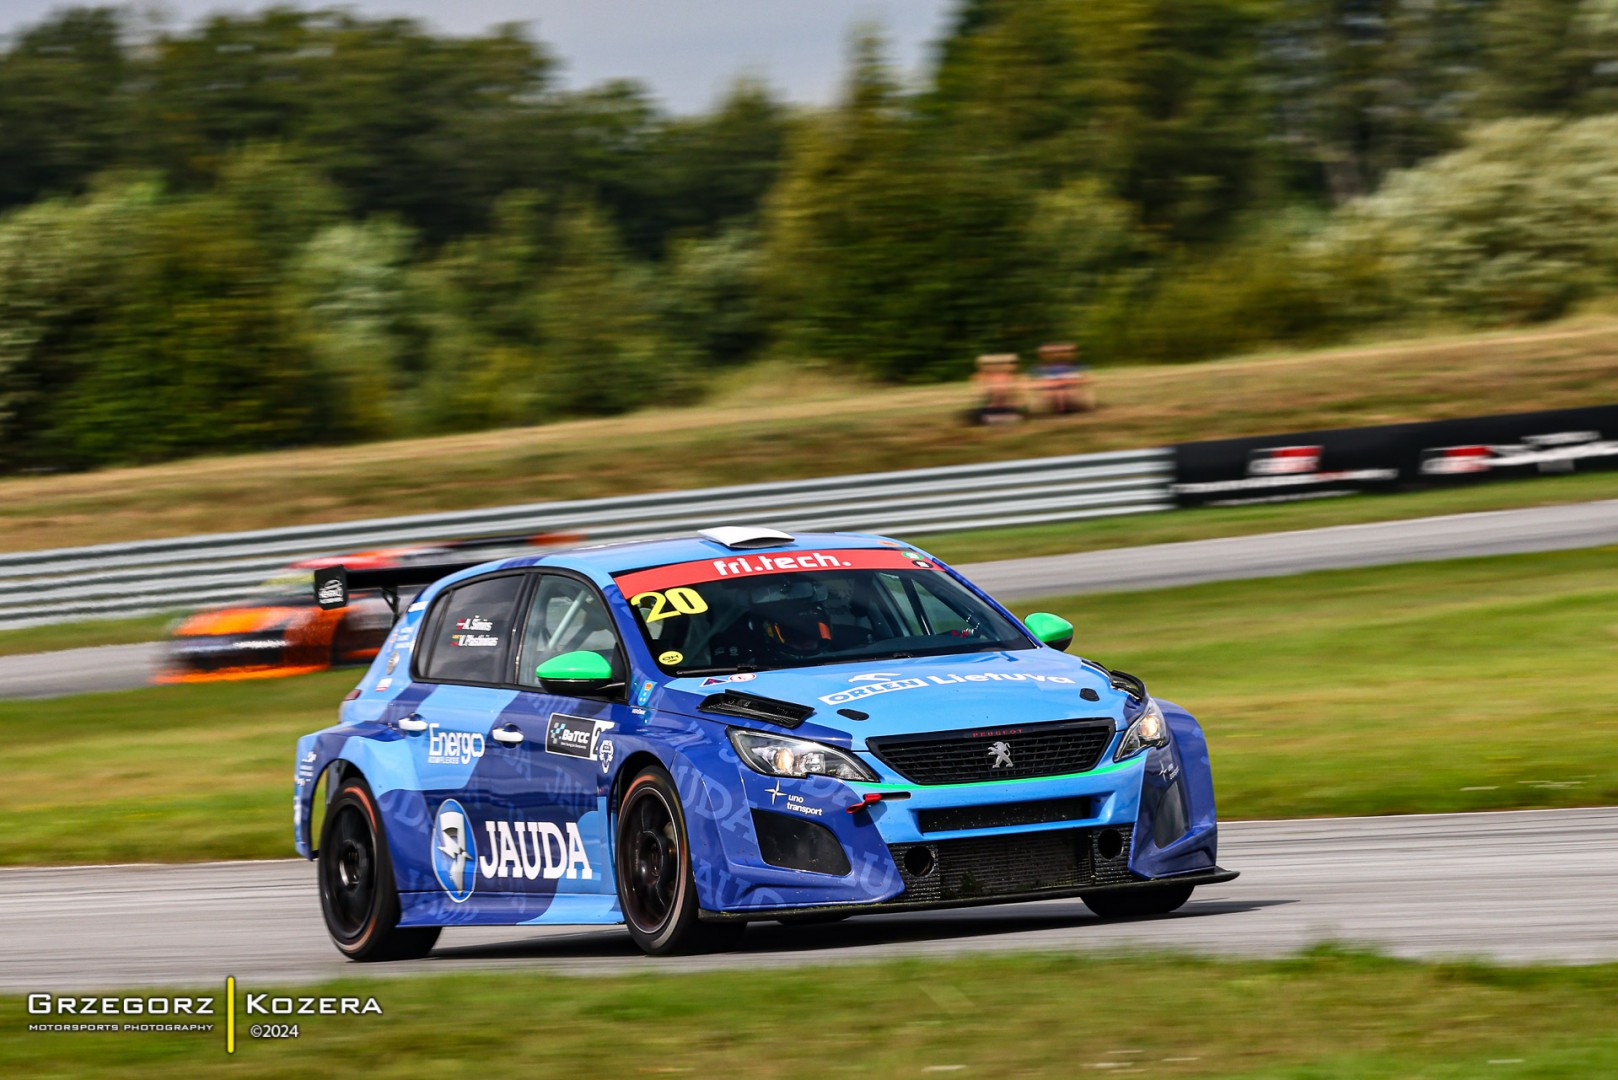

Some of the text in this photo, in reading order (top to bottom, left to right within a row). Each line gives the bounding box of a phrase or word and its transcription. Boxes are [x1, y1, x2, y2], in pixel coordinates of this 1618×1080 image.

[713, 552, 852, 576] fri.tech.
[630, 587, 709, 623] 20
[826, 672, 1076, 702] ORLEN Lietuva
[429, 723, 485, 764] Energo
[972, 728, 1023, 738] PEUGEOT
[786, 802, 823, 816] transport
[788, 793, 804, 803] uno
[479, 820, 593, 880] JAUDA
